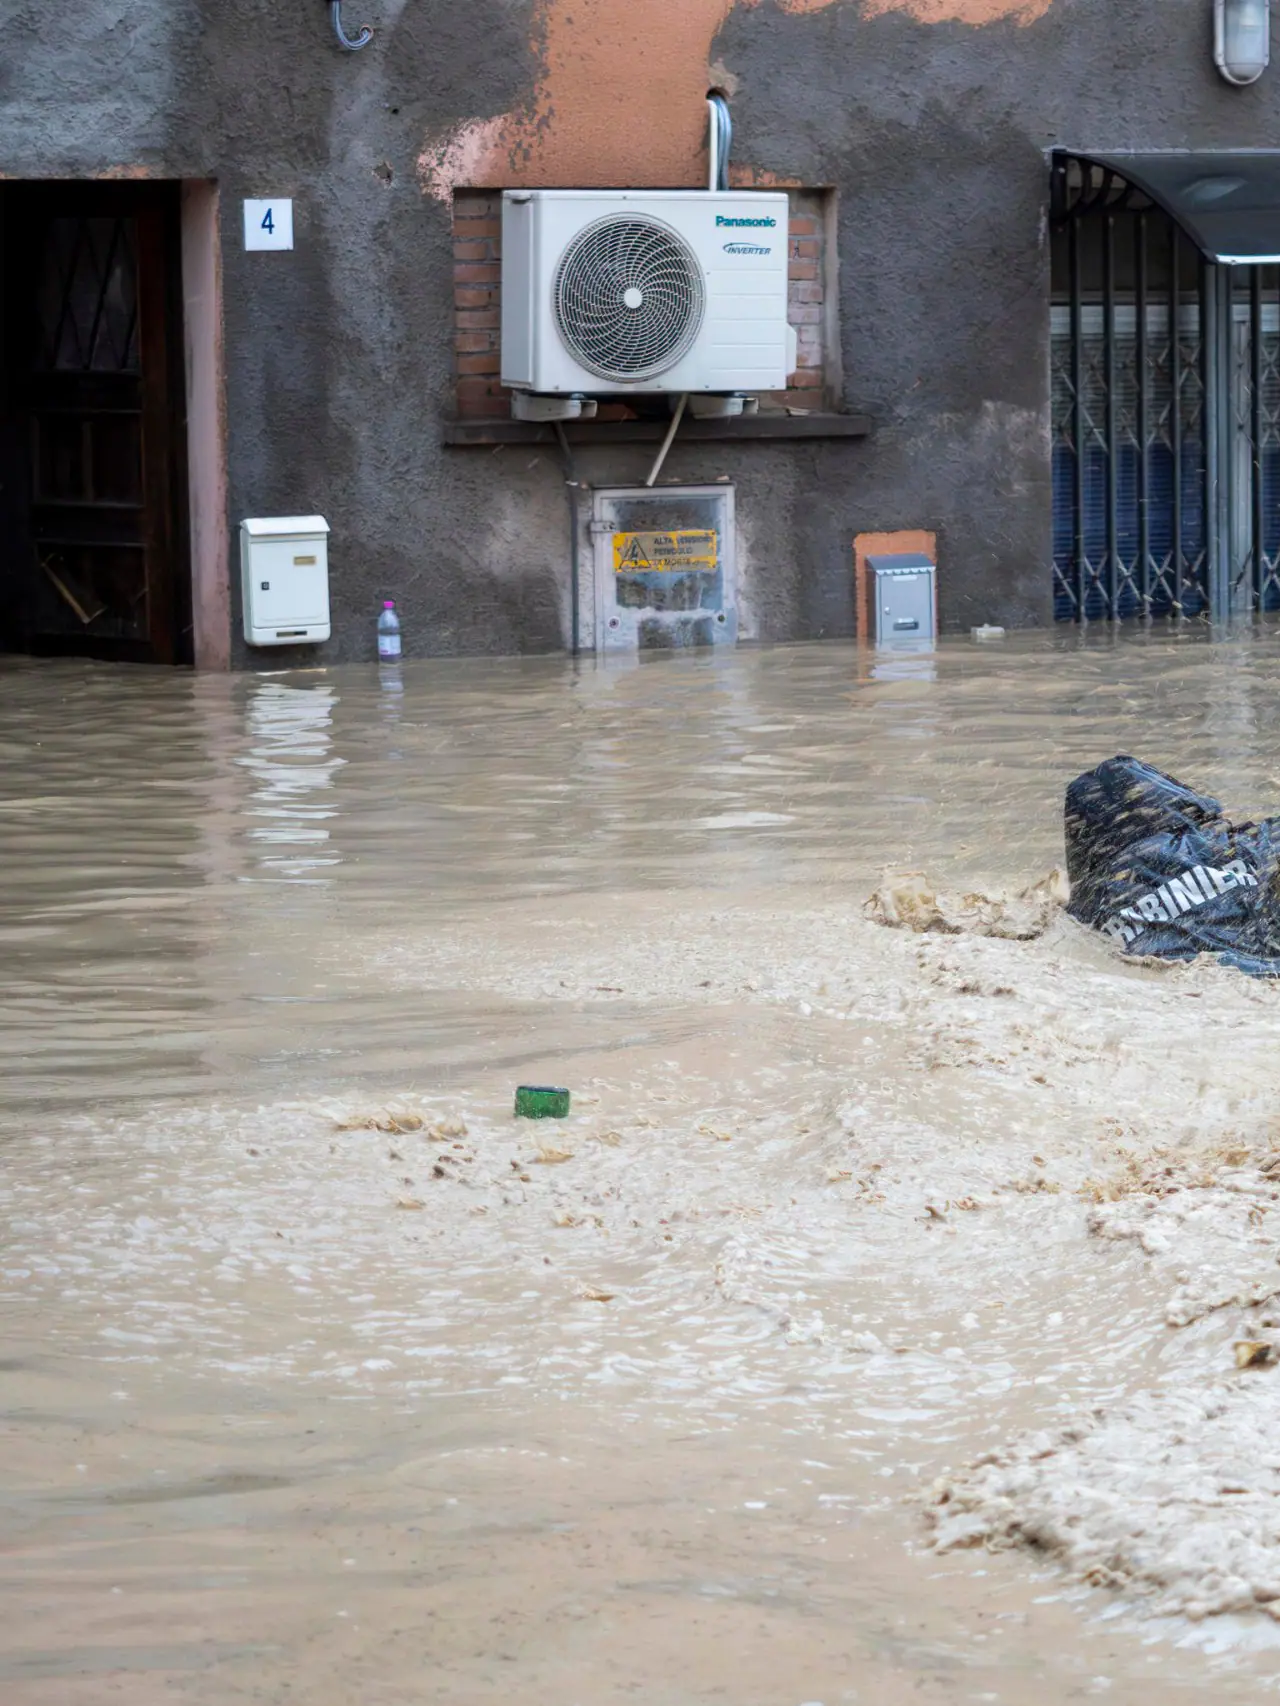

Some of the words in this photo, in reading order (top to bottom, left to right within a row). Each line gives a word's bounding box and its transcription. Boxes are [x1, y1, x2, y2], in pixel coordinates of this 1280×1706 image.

[261, 207, 275, 235] 4
[715, 215, 776, 228] Panasonic
[727, 246, 771, 255] INVERTER
